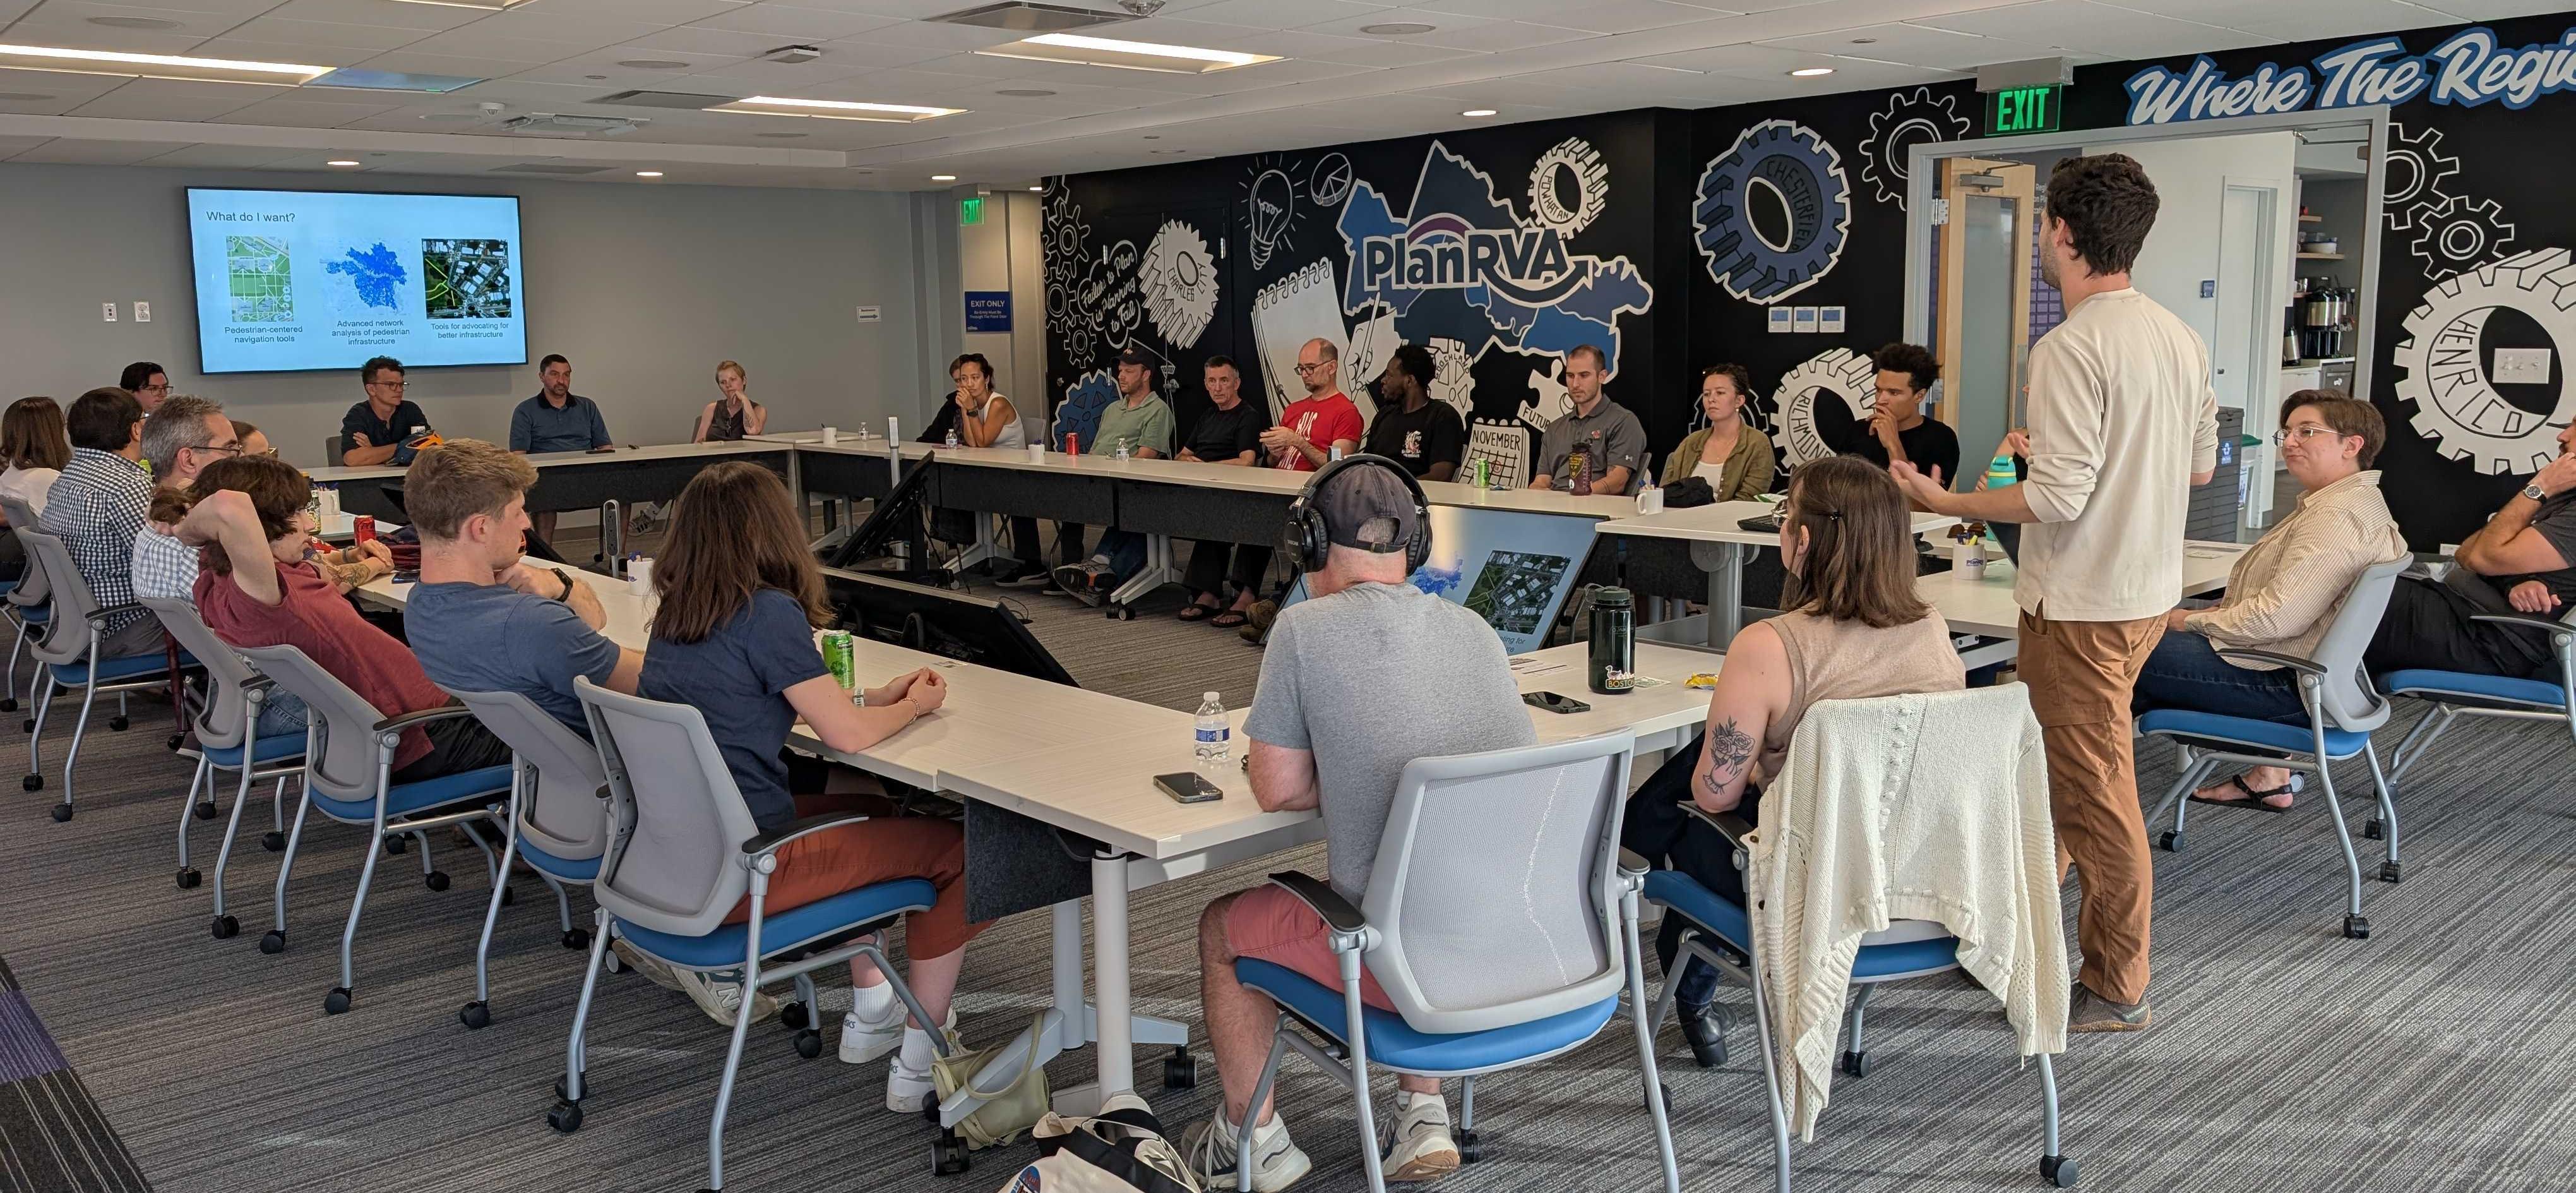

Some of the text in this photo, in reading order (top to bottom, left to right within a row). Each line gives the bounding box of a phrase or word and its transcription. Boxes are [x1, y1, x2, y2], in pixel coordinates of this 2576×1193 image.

[2131, 32, 2576, 124] Where The Regi
[1997, 88, 2049, 131] EXIT
[963, 200, 980, 223] EXIT
[1541, 175, 1569, 219] POWHATAN
[1766, 160, 1815, 251] CHESTERFIELD
[206, 211, 295, 222] What do I want?
[1364, 227, 1571, 292] PlanRVA
[1081, 252, 1135, 309] Failure to Plan
[1167, 263, 1207, 302] CHARLES CITY
[224, 326, 303, 334] Pedestrian-centered
[1095, 309, 1103, 323] is
[1111, 300, 1136, 333] to Fail
[234, 336, 275, 344] navigation
[373, 328, 410, 337] pedestrian
[1434, 353, 1470, 379] GOOCHLAND
[2431, 320, 2522, 433] HENRICO
[1522, 407, 1551, 430] FUTUR
[1472, 430, 1521, 451] NOVEMBER
